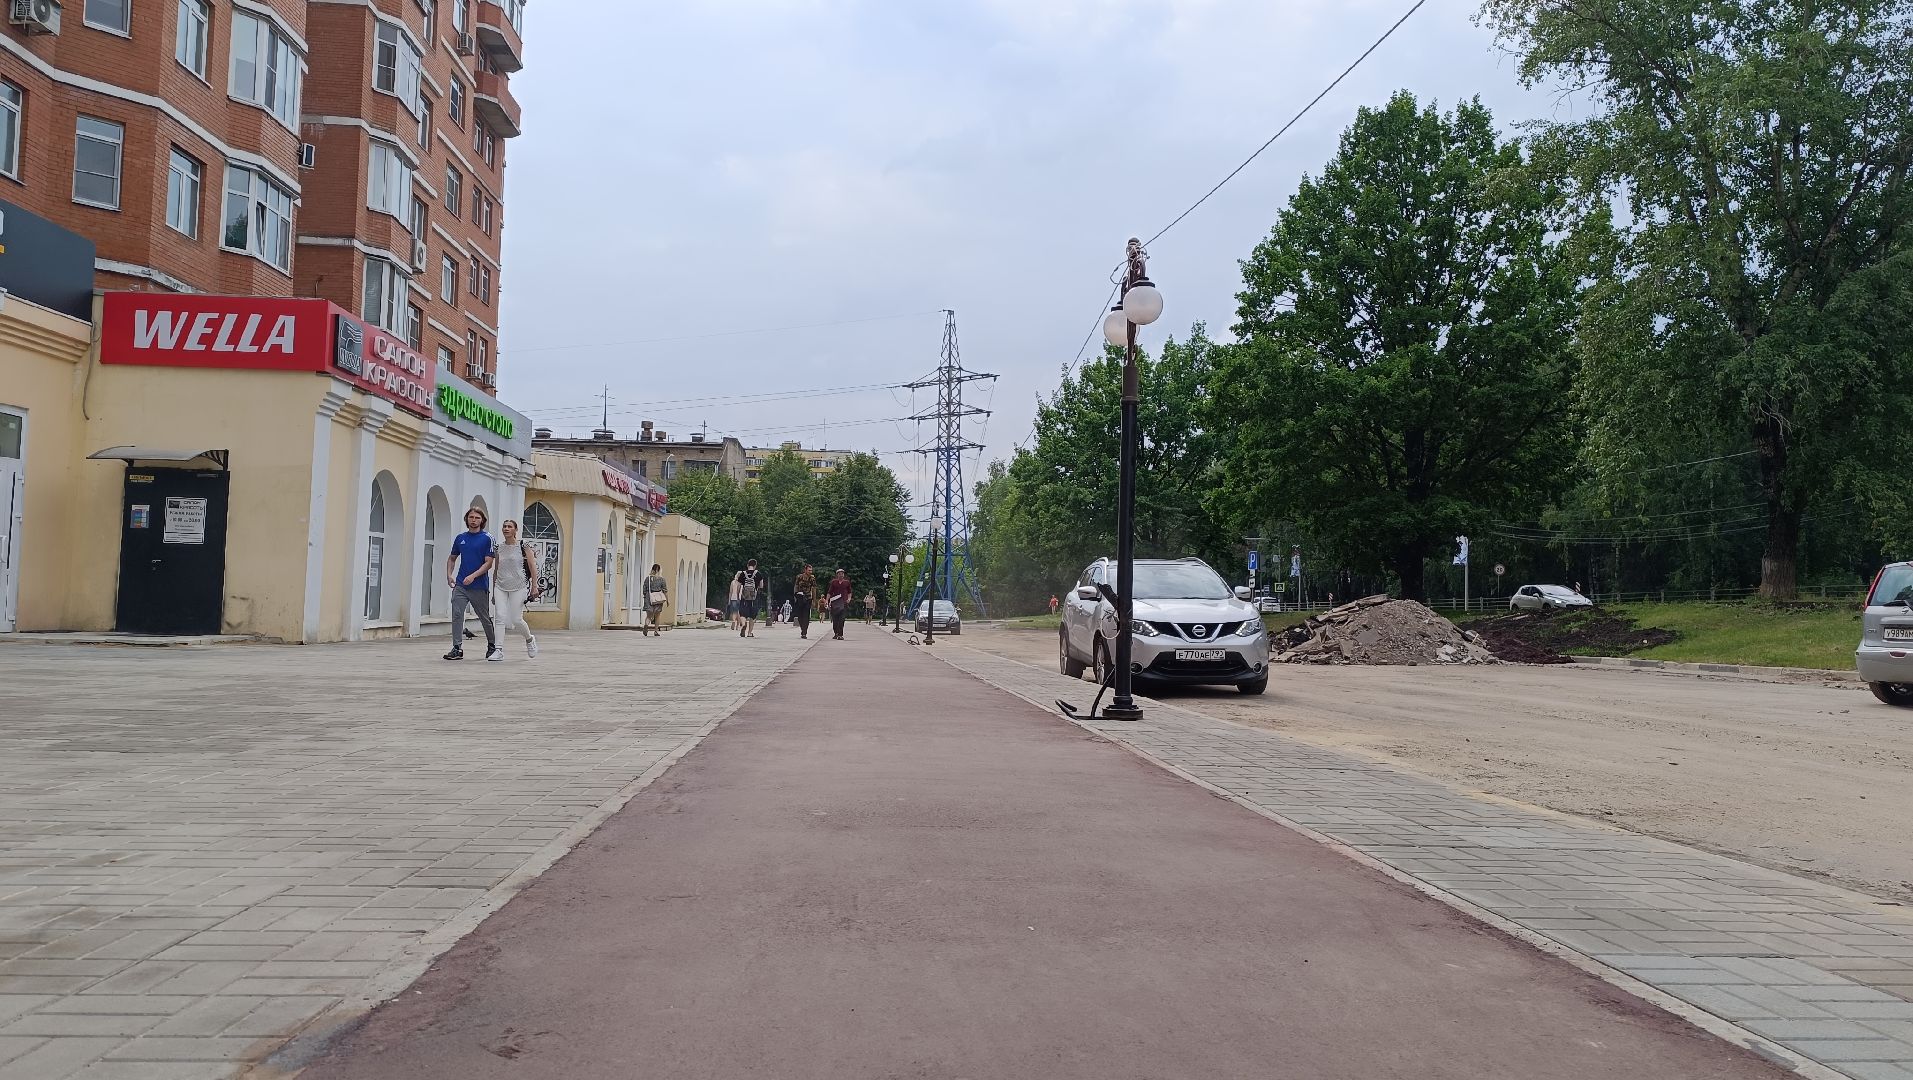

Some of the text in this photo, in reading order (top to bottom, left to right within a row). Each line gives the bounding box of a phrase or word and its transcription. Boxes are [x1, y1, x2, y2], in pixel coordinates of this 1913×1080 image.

[133, 309, 296, 354] WELLA
[374, 335, 426, 380] САЛОН
[362, 359, 434, 411] КРАСОТЫ
